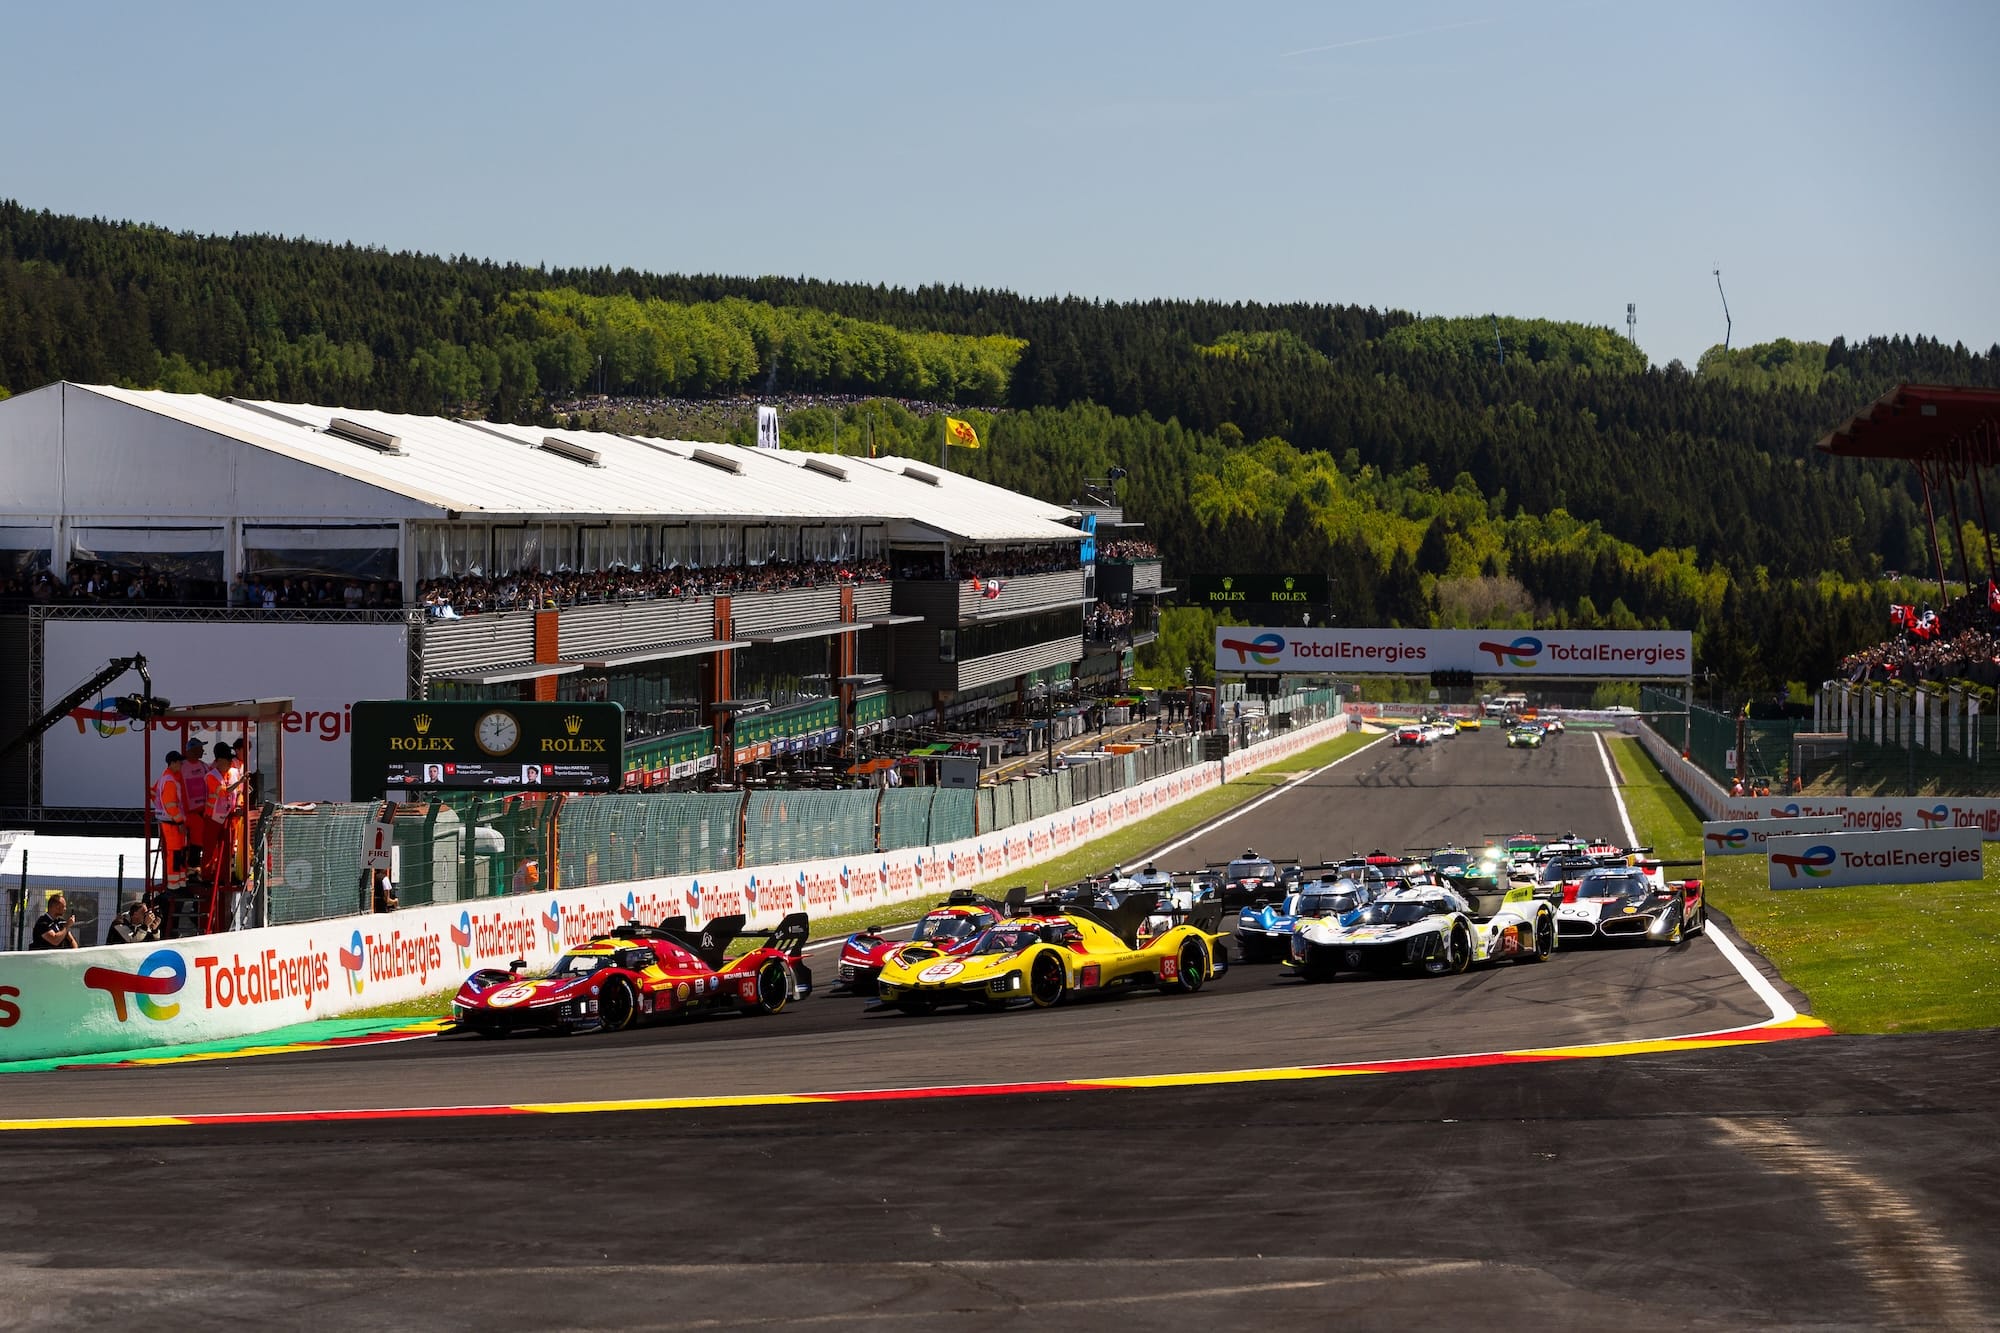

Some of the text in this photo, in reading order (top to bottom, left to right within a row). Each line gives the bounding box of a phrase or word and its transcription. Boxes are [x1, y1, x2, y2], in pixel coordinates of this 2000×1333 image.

[1209, 591, 1246, 601] ROLEX
[1271, 591, 1307, 601] ROLEX
[1289, 641, 1427, 663] TotalEnergies
[1547, 643, 1686, 665] TotalEnergies
[390, 737, 455, 750] ROLEX
[541, 738, 606, 752] ROLEX
[368, 850, 390, 858] FIRE
[1840, 845, 1981, 869] TotalEnergies
[756, 873, 793, 918] TotalEnergies
[472, 906, 536, 960] TotalEnergies
[1504, 935, 1518, 951] 94
[364, 921, 442, 986] TotalEnergies
[195, 939, 330, 1010] TotalEnergies
[1164, 959, 1175, 975] 83
[723, 971, 742, 980] RICHARD
[742, 981, 755, 997] 50
